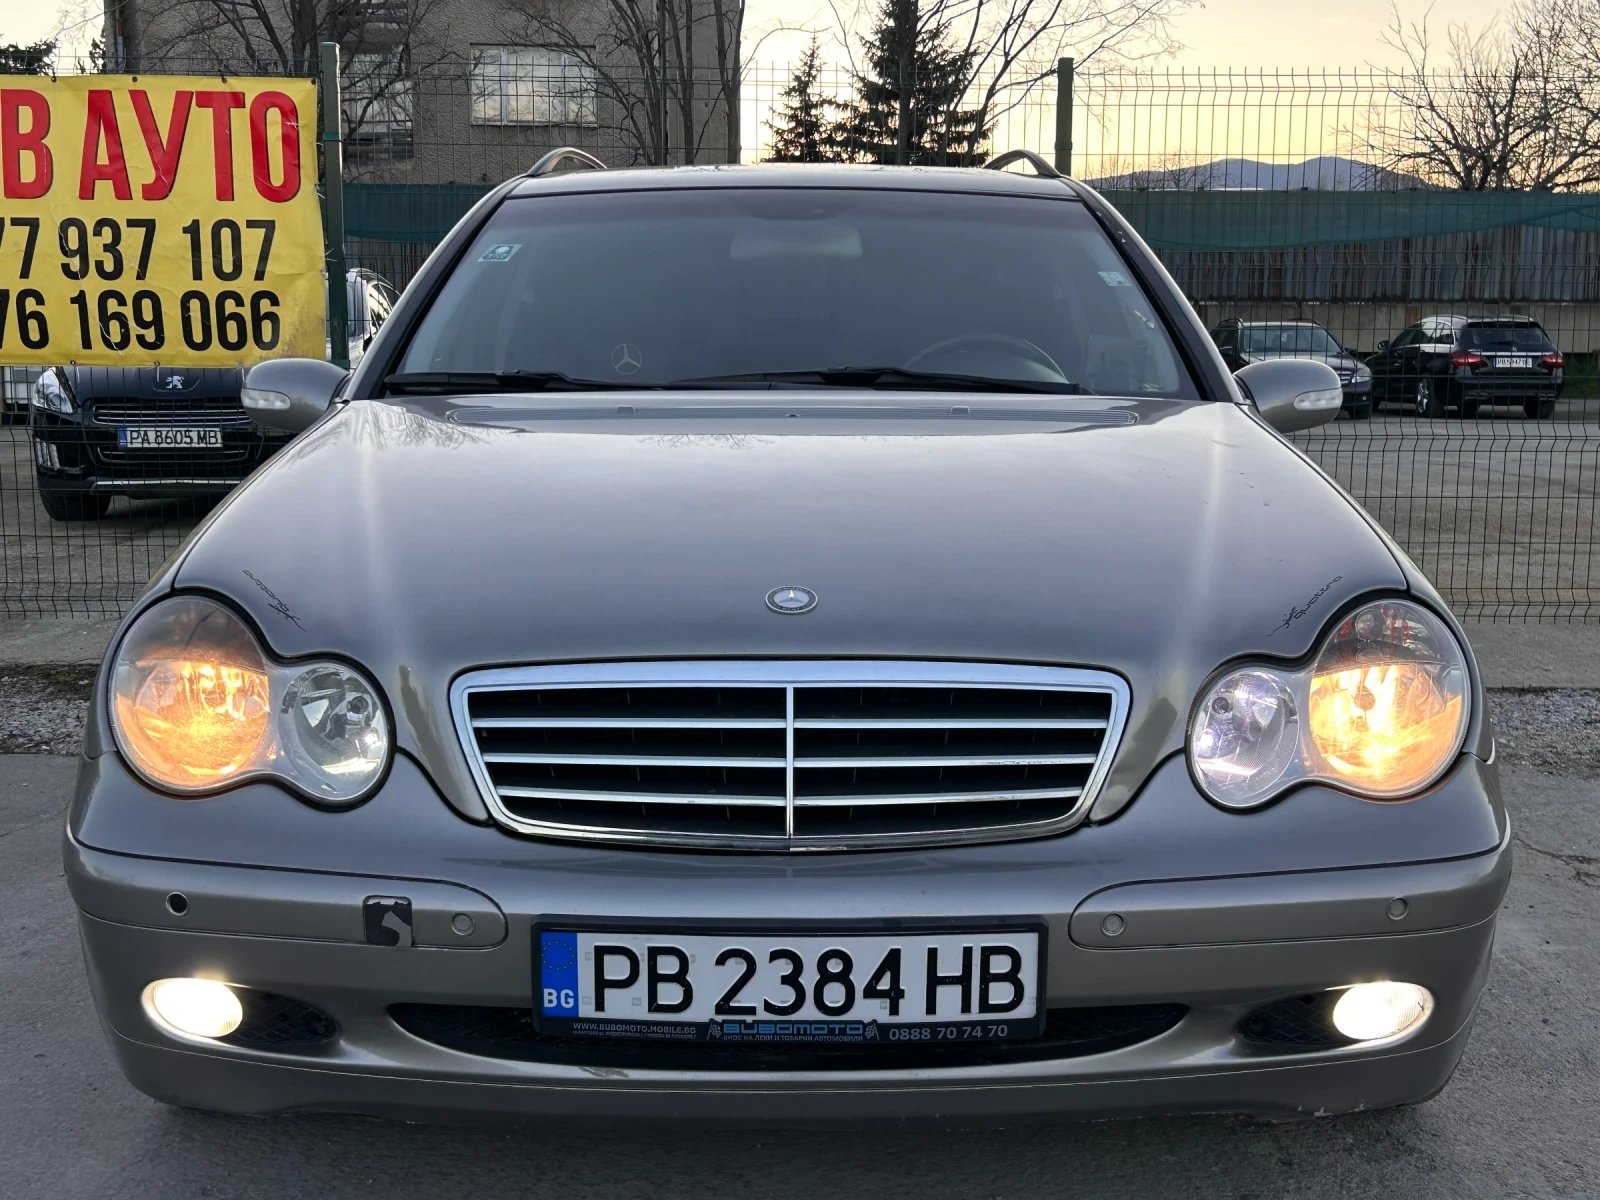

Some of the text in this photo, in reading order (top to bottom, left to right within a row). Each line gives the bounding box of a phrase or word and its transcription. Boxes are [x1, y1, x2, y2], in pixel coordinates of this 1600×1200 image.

[78, 88, 301, 203] АУТО
[0, 216, 276, 282] 7 937 107
[69, 289, 165, 351] 169
[180, 290, 281, 352] 066
[130, 430, 150, 445] PA
[155, 430, 193, 445] 8605
[198, 430, 218, 445] MB
[593, 944, 1025, 1016] PB 2384 HB
[543, 988, 575, 1009] BG
[573, 1022, 697, 1034] WWW.BUBOMOTO.MOBILE.BG
[723, 1023, 864, 1035] BUBOMOTO
[888, 1024, 1008, 1040] 0888 70 74 70
